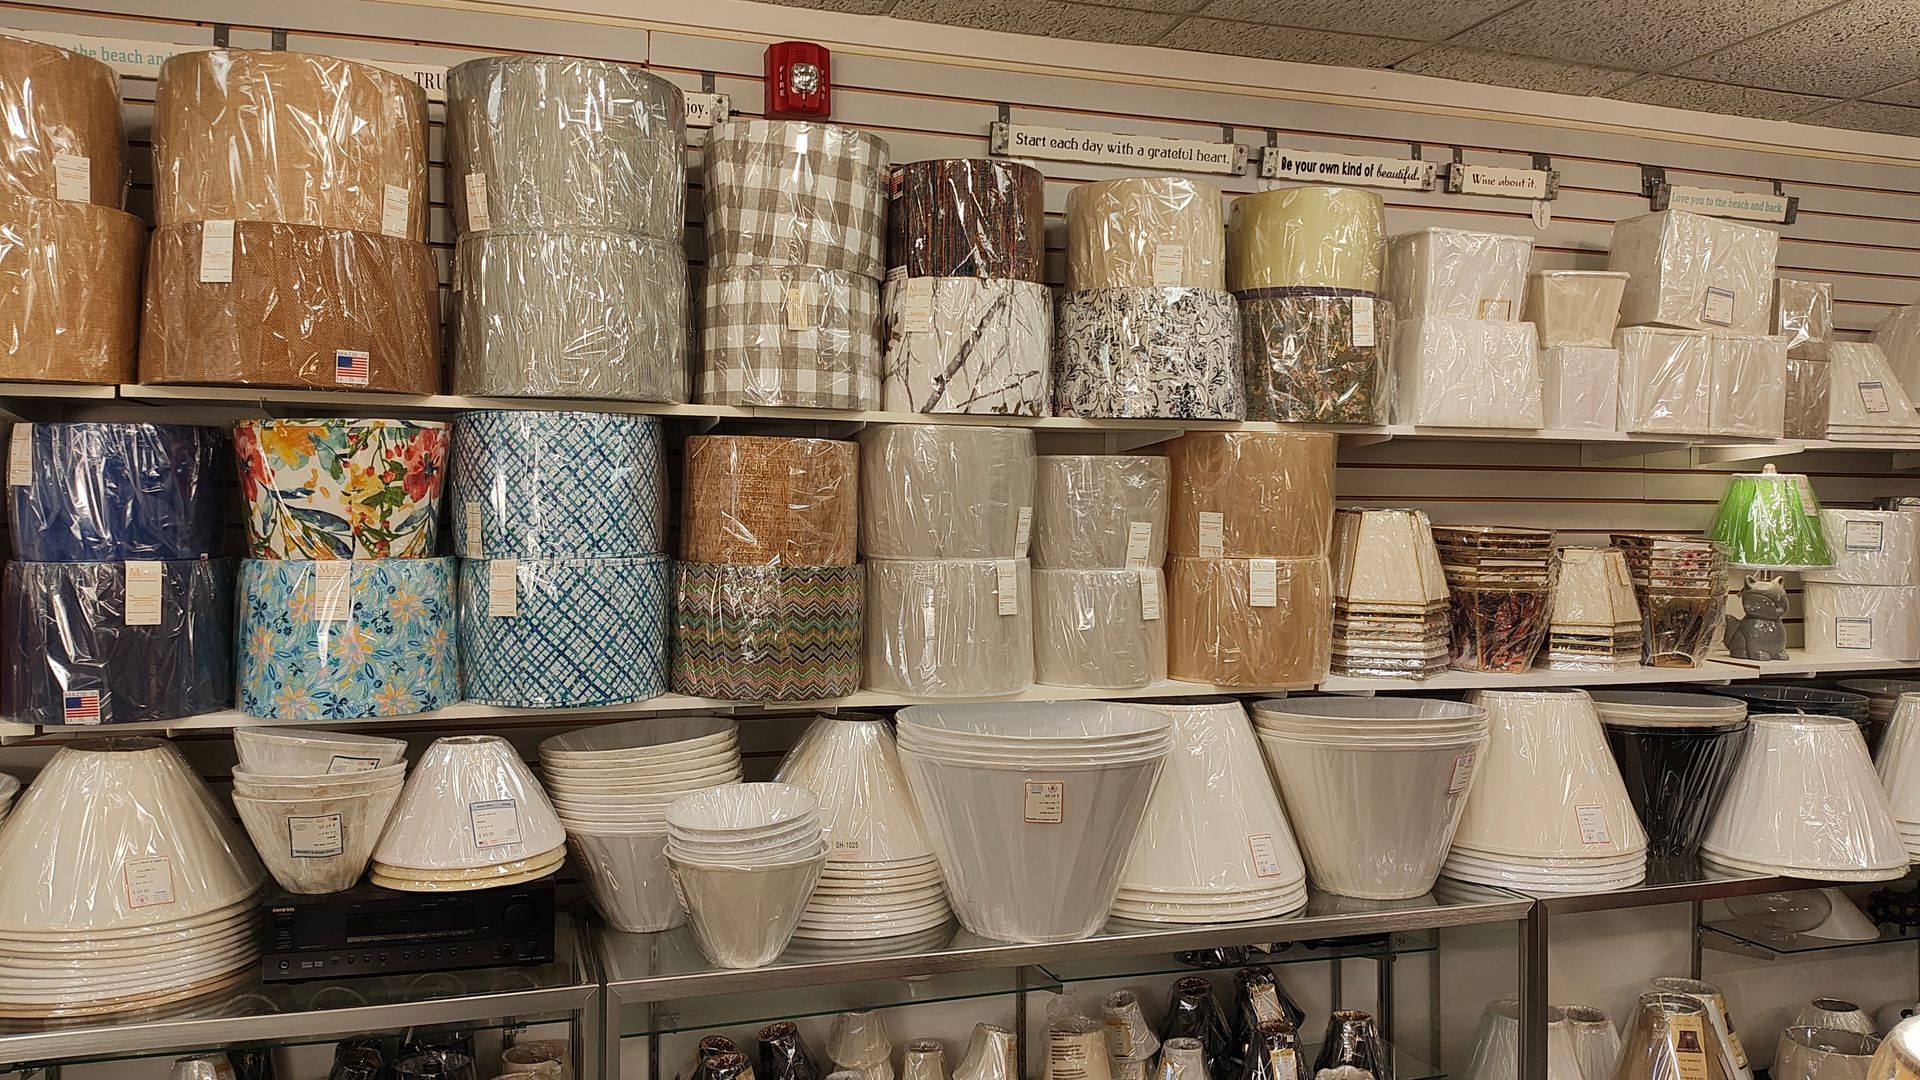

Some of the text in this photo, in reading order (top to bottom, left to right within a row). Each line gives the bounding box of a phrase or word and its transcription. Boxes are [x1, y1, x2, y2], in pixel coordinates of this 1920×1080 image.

[101, 46, 144, 65] beach
[686, 98, 708, 118] joy.
[1015, 133, 1230, 165] Start each day with a grateful heart.
[1281, 156, 1420, 184] Be your own kind of beautiful.
[1472, 173, 1537, 189] Wine about it.
[1672, 192, 1783, 213] Love you to the beach and back.
[835, 841, 859, 849] SH-1025
